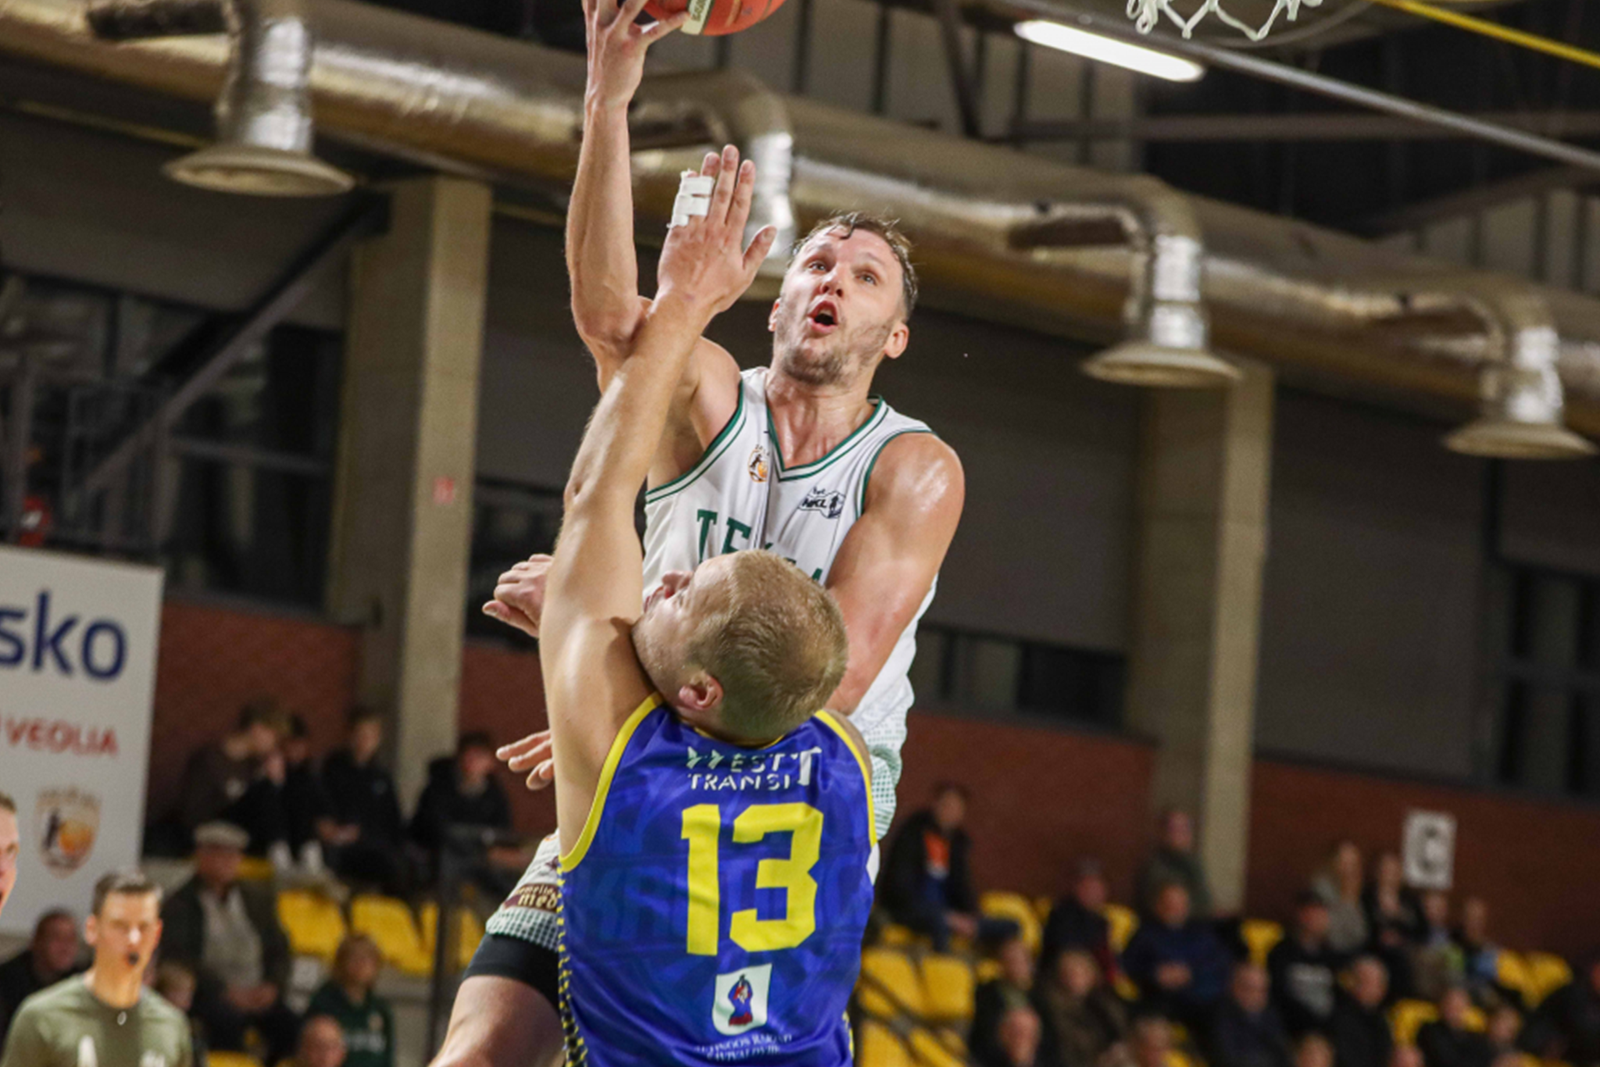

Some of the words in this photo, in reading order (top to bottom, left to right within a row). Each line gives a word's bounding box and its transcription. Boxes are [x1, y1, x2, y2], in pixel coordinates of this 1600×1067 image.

[0, 590, 127, 682] sko
[5, 717, 119, 756] VEOLIA
[681, 802, 824, 956] 13
